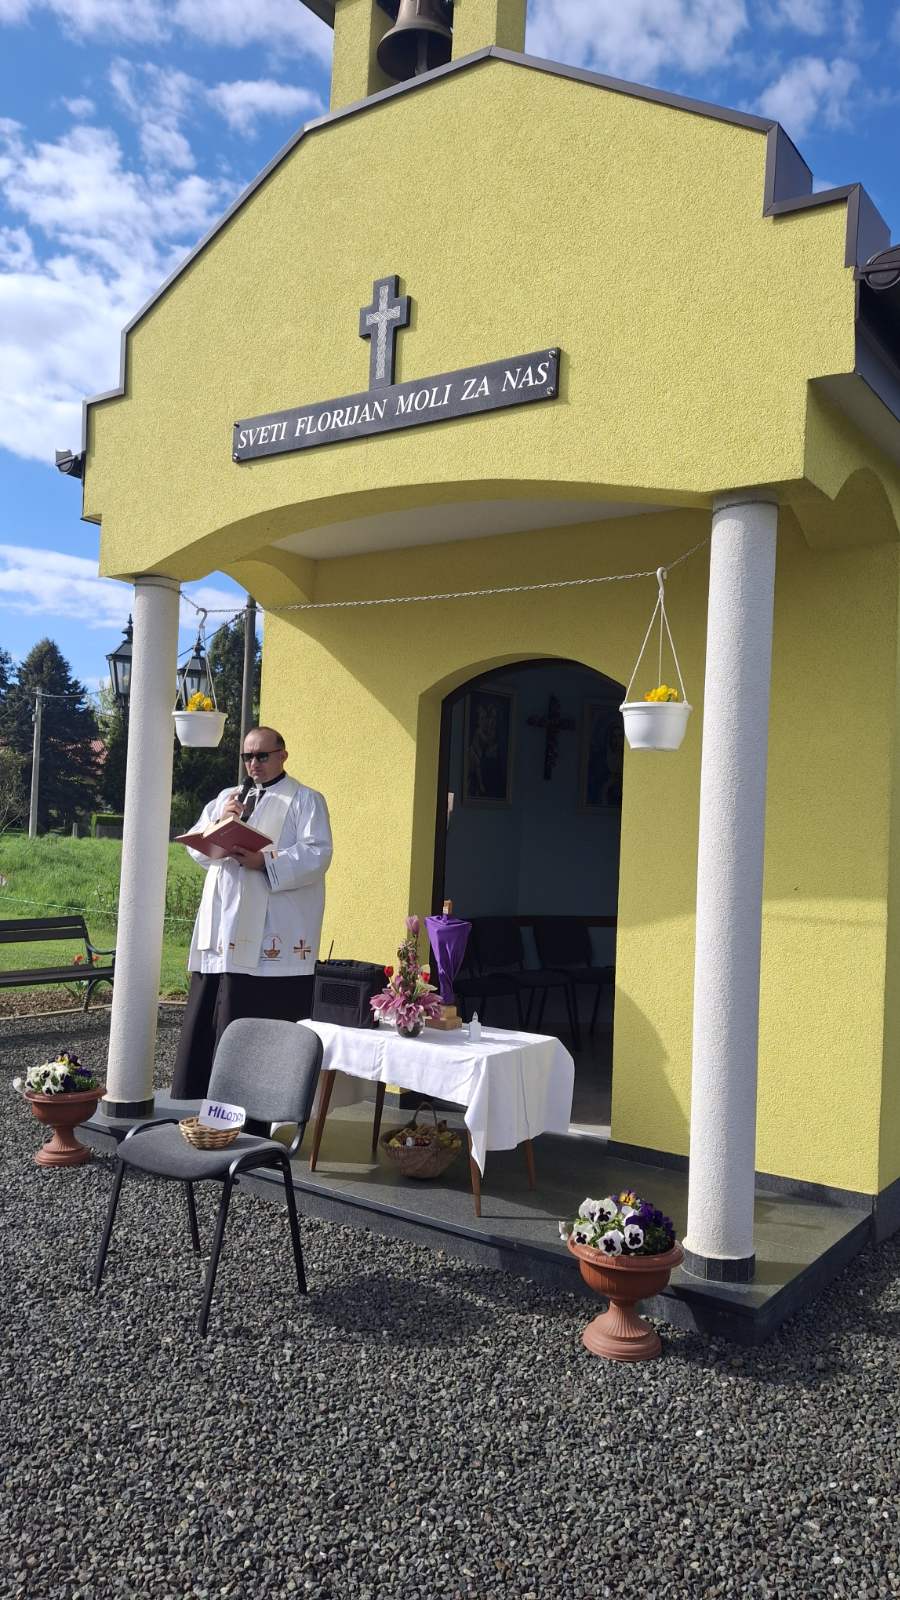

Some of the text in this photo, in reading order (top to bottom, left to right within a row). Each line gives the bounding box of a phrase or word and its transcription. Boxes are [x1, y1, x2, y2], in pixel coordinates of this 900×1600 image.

[238, 362, 549, 449] SVETI FLORIJAN MOLI ZA NAS
